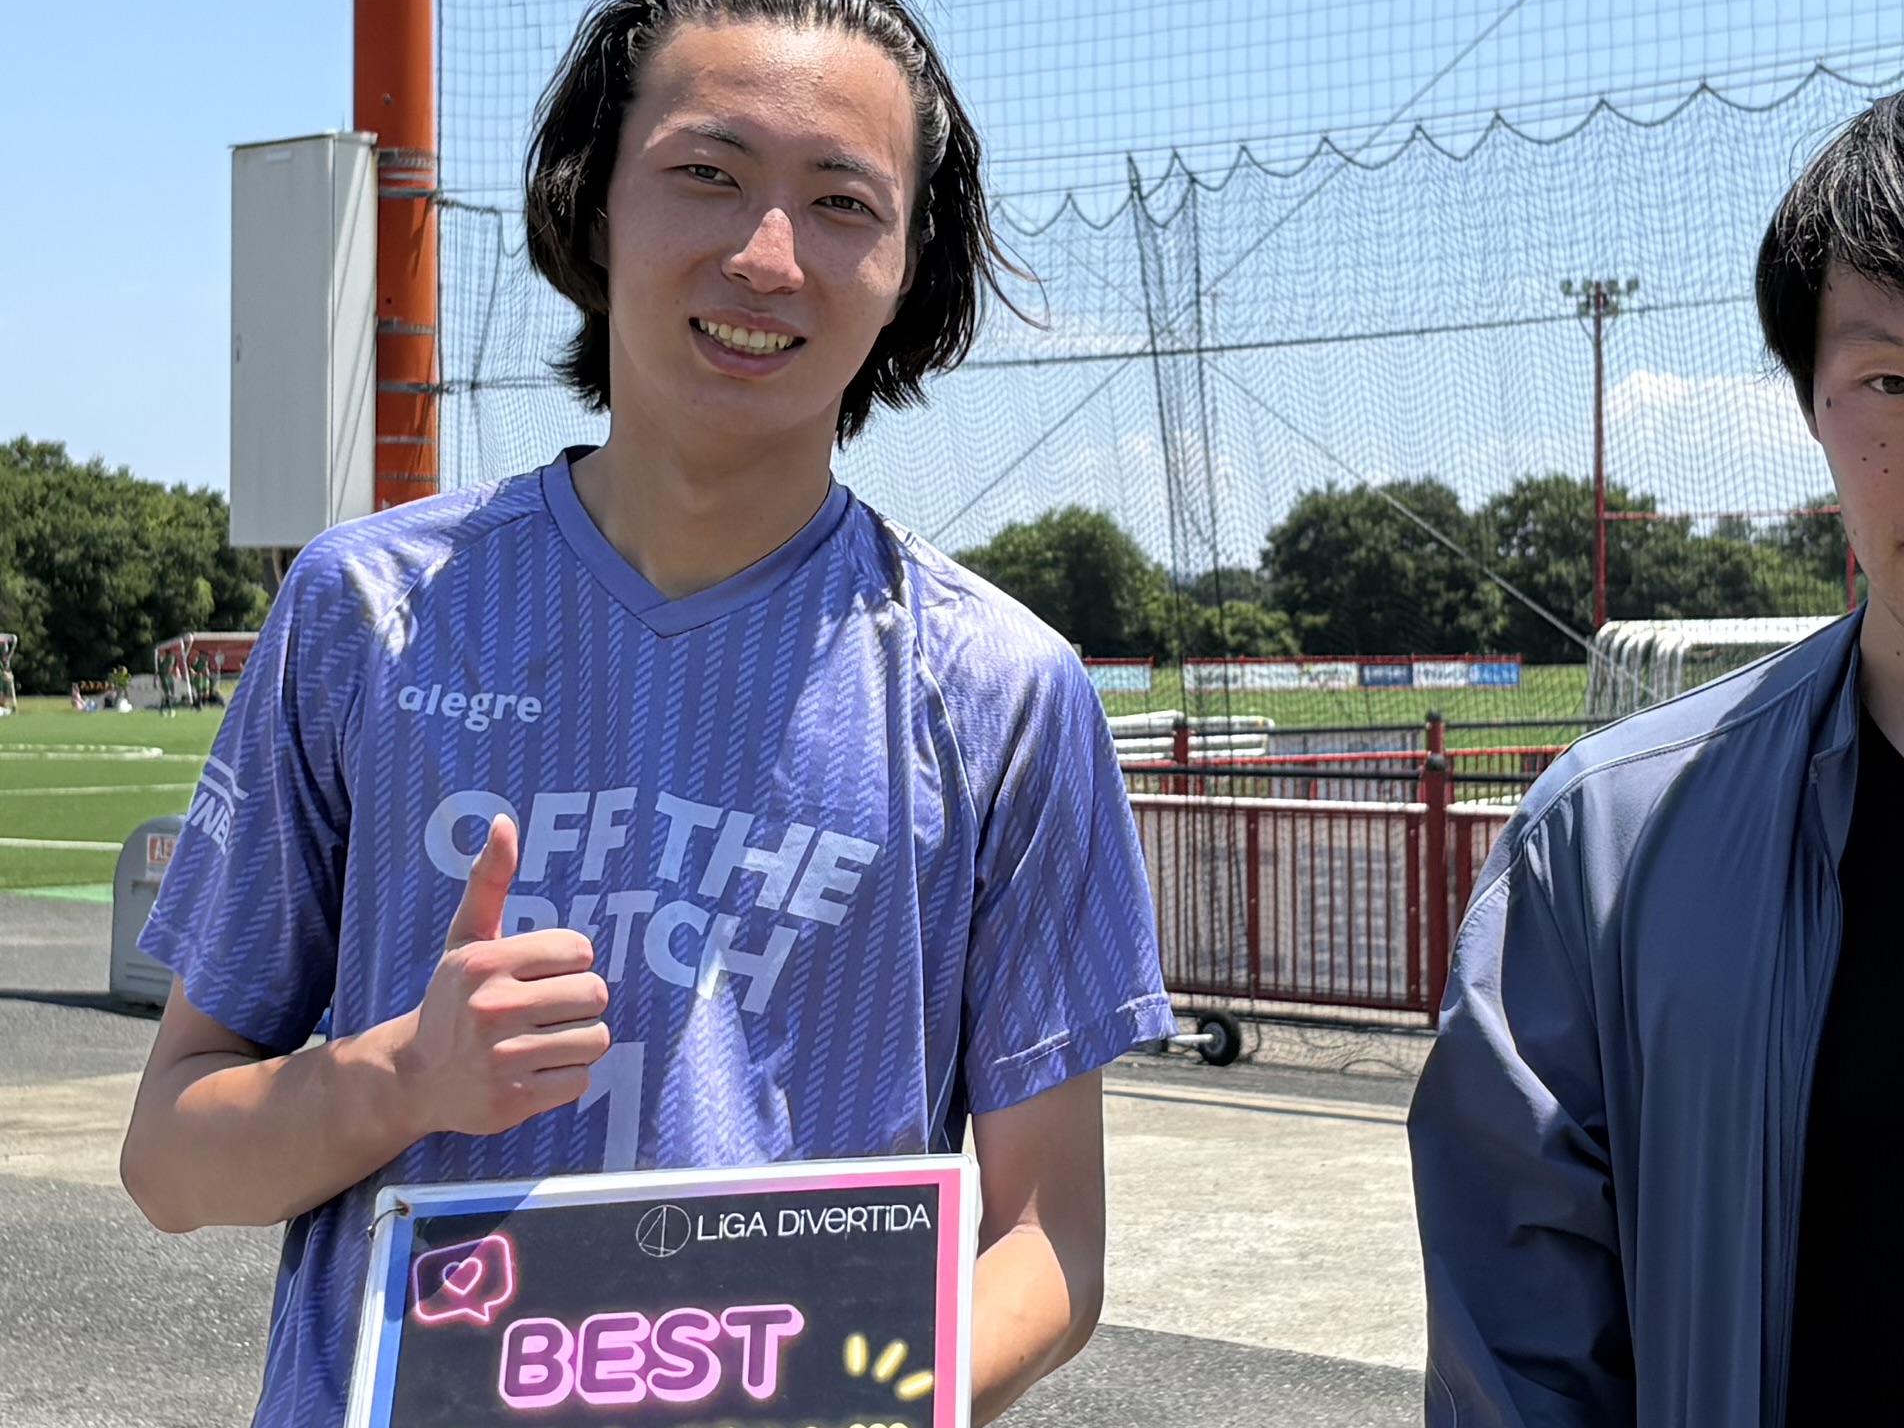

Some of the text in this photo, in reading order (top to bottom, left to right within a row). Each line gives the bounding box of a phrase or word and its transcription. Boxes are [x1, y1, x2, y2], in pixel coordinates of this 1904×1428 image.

[397, 683, 543, 732] alegre
[424, 787, 880, 926] OFF THE
[499, 1304, 804, 1409] BEST
